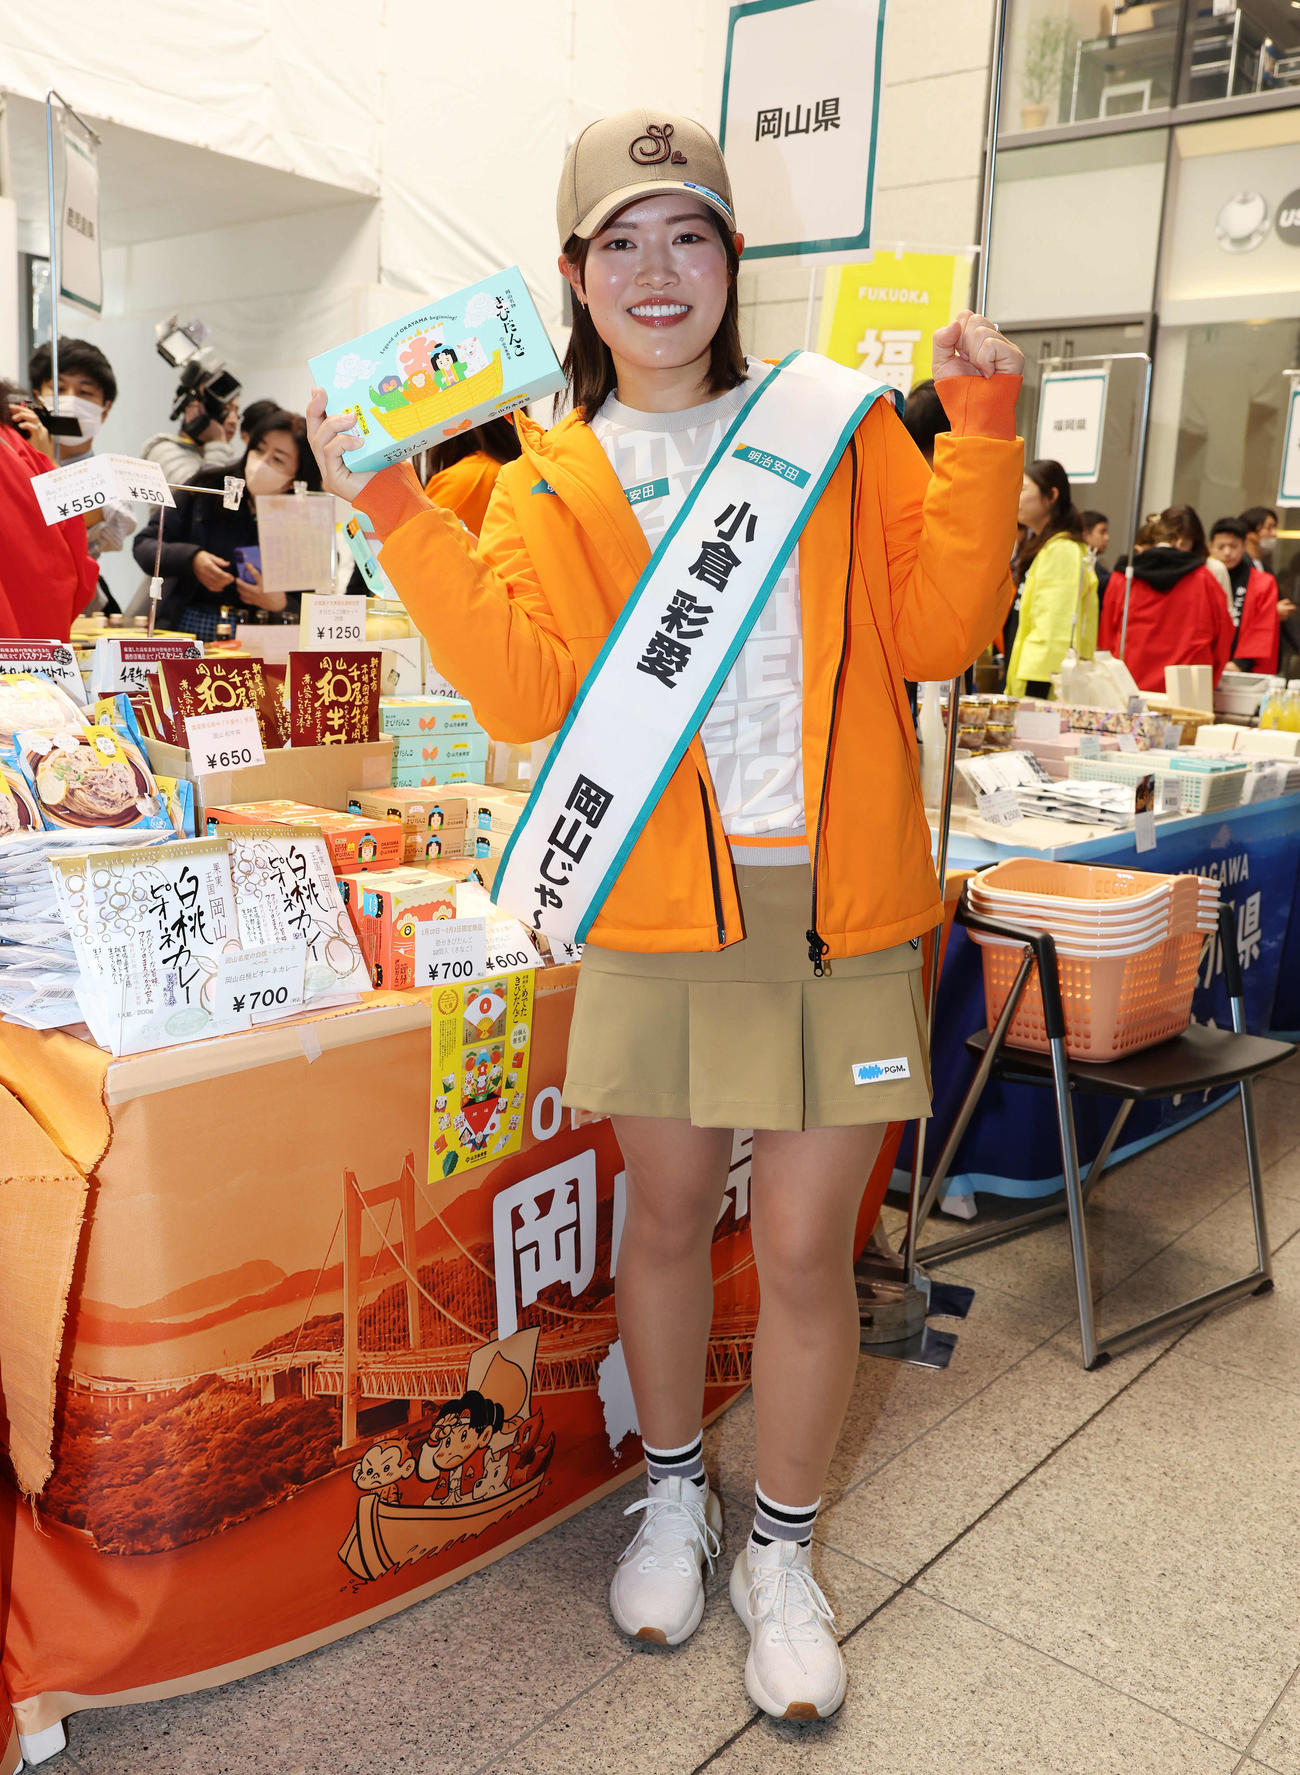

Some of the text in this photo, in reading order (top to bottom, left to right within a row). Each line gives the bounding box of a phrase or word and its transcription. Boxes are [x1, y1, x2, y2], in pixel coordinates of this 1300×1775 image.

[755, 97, 841, 142] 岡山県
[857, 285, 929, 305] FUKUOKA
[399, 316, 428, 333] OKAYAMA
[495, 296, 525, 357] きびだんご
[747, 449, 799, 481] 明治安田
[57, 491, 106, 517] ¥550
[129, 486, 165, 503] ¥550
[626, 485, 654, 502] 安田
[316, 626, 361, 640] ¥1250
[195, 663, 226, 676] 岡山
[319, 656, 347, 670] 岡山
[206, 748, 252, 769] ¥650
[269, 856, 294, 913] ピオーネ
[286, 845, 328, 961] 白桃カレー
[149, 883, 177, 951] ピオーネ
[209, 897, 227, 941] 岡山
[161, 866, 214, 1004] 白桃カレー
[428, 960, 473, 981] ¥700
[486, 951, 528, 970] ¥600
[232, 986, 288, 1012] ¥700
